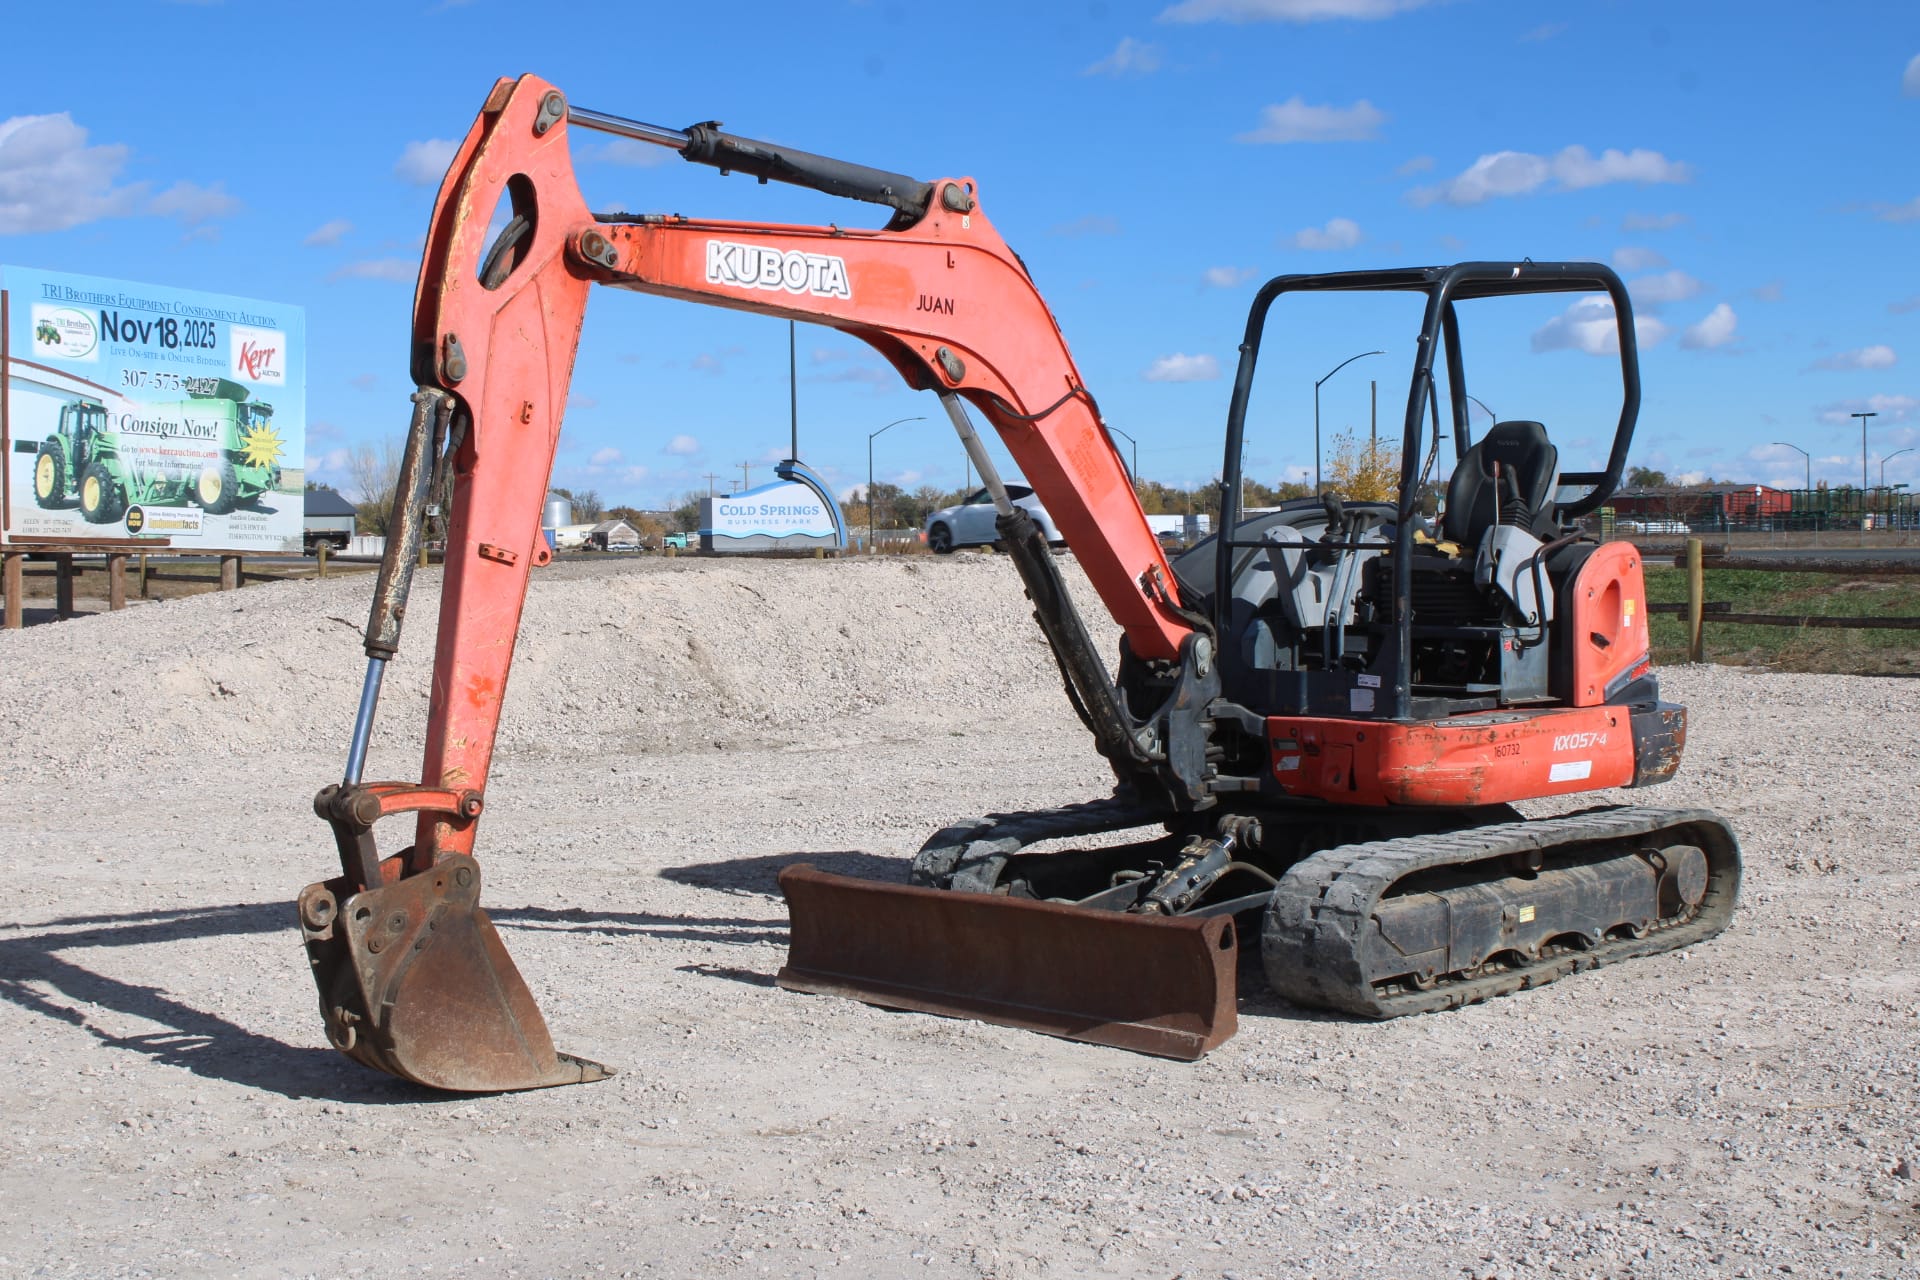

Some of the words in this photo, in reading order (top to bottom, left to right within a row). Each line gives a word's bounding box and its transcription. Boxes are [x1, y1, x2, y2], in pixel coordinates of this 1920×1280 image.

[707, 240, 851, 298] KUBOTA
[41, 283, 62, 298] TRI
[65, 286, 116, 305] BROTHERS
[119, 293, 171, 313] EQUIPMENT
[174, 301, 237, 321] CONSIGNMENT
[239, 311, 277, 326] AUCTION
[916, 294, 955, 316] JUAN
[184, 319, 216, 349] 2025
[111, 346, 125, 356] LIVE
[128, 348, 159, 360] ON-SITE
[168, 352, 194, 364] ONLINE
[197, 355, 226, 367] BIDDING
[238, 340, 276, 380] Kerr
[121, 369, 219, 395] 307-575-2427
[120, 413, 178, 440] Consign
[183, 418, 218, 438] Now!
[121, 444, 130, 453] Go
[139, 445, 218, 459] www.kerrauction.com
[135, 458, 145, 467] For
[147, 459, 162, 469] More
[719, 504, 756, 516] COLD
[760, 504, 819, 516] SPRINGS
[1494, 743, 1520, 757] 160732
[1553, 733, 1608, 751] KX057-4
